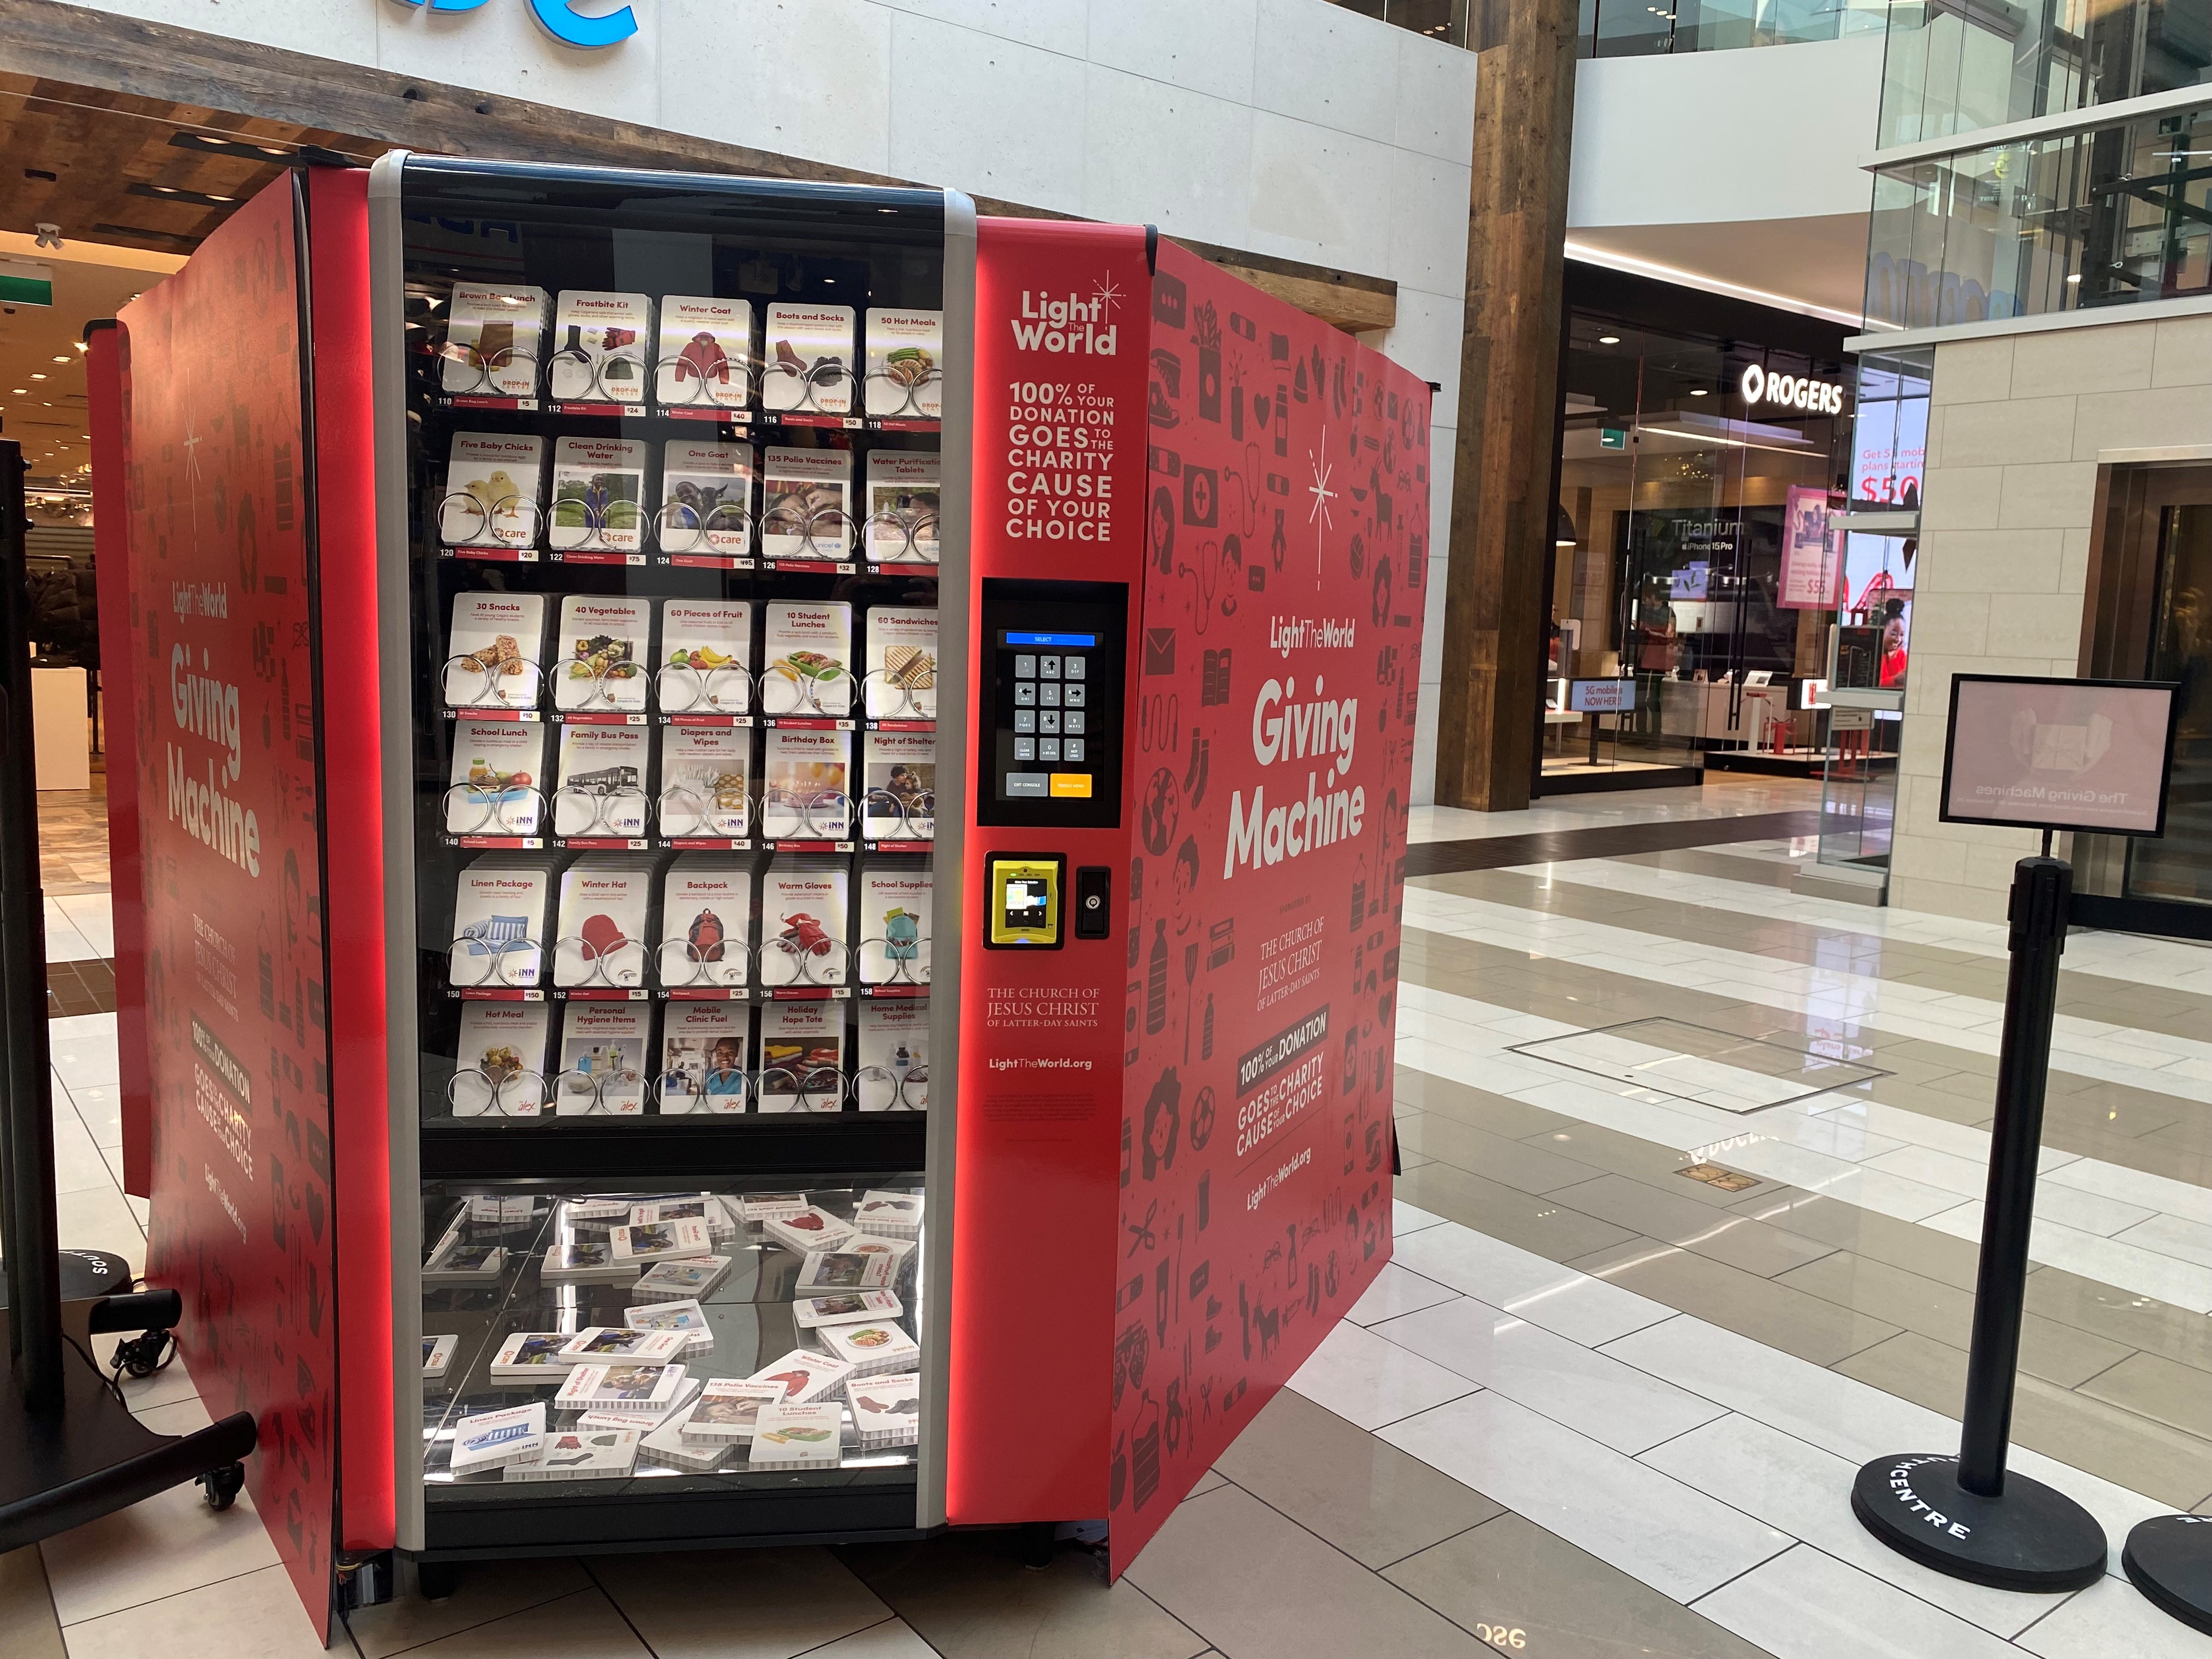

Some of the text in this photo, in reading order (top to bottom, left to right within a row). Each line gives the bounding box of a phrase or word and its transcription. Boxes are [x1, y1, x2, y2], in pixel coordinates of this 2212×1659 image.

[459, 291, 487, 300] Brown
[577, 299, 614, 309] Frostbite
[680, 305, 708, 313] Winter
[1022, 290, 1102, 329] Light
[1068, 322, 1084, 332] The
[1011, 320, 1116, 355] World
[1009, 382, 1072, 405] 100%
[1077, 383, 1095, 393] OF
[1766, 372, 1843, 414] ROGERS
[1077, 396, 1114, 408] YOUR
[1010, 406, 1114, 425] DONATION
[1009, 424, 1088, 448] GOES
[1094, 429, 1110, 438] TO
[481, 442, 503, 451] Baby
[505, 443, 533, 451] Chicks
[597, 443, 633, 453] Drinking
[1091, 440, 1113, 450] THE
[1008, 449, 1114, 471] CHARITY
[1863, 449, 1881, 459] Get
[806, 457, 842, 465] Vaccines
[1862, 461, 1888, 473] plans
[1007, 471, 1112, 498] CAUSE
[1008, 498, 1110, 518] OF YOUR
[1006, 518, 1111, 541] CHOICE
[1672, 518, 1745, 536] Titanium
[505, 529, 526, 538] care
[172, 580, 227, 624] LightTheWorld
[588, 607, 635, 616] Vegetables
[890, 617, 938, 625] Sandwiches
[1270, 616, 1355, 658] LightTheWorld
[1585, 686, 1595, 695] 5G
[1585, 697, 1602, 706] NOW
[172, 643, 241, 781] Giving
[1253, 675, 1357, 775] Giving
[571, 731, 599, 740] Family
[681, 729, 713, 738] Diapers
[693, 738, 719, 747] Wipes
[782, 736, 817, 745] Birthday
[874, 737, 894, 746] Night
[167, 741, 260, 878] Machine
[1223, 768, 1365, 880] Machine
[496, 880, 533, 889] Package
[687, 882, 728, 891] Backpack
[805, 882, 832, 890] Gloves
[900, 881, 933, 890] Supplies
[1261, 916, 1324, 961] THE CHURCH OF
[1257, 939, 1323, 997] JESUS CHRIST
[988, 988, 1100, 998] THE CHURCH OF
[1257, 967, 1320, 1012] OF LATTER-DAY SAINTS
[788, 1006, 818, 1015] Holiday
[987, 1002, 1099, 1018] JESUS CHRIST
[577, 1015, 611, 1025] Hygiene
[782, 1015, 802, 1025] Hope
[883, 1012, 916, 1022] Supplies
[1279, 1012, 1327, 1061] DONATION
[989, 1058, 1092, 1070] LightTheWorld.org
[1240, 1054, 1265, 1086] 100%
[215, 1043, 250, 1104] DONATION
[1280, 1051, 1324, 1100] CHARITY
[1285, 1075, 1323, 1119] CHOICE
[1238, 1090, 1269, 1130] GOES
[1237, 1112, 1273, 1156] CAUSE
[225, 1133, 253, 1182] CHOICE
[1248, 1147, 1311, 1211] LightTheWorld.org
